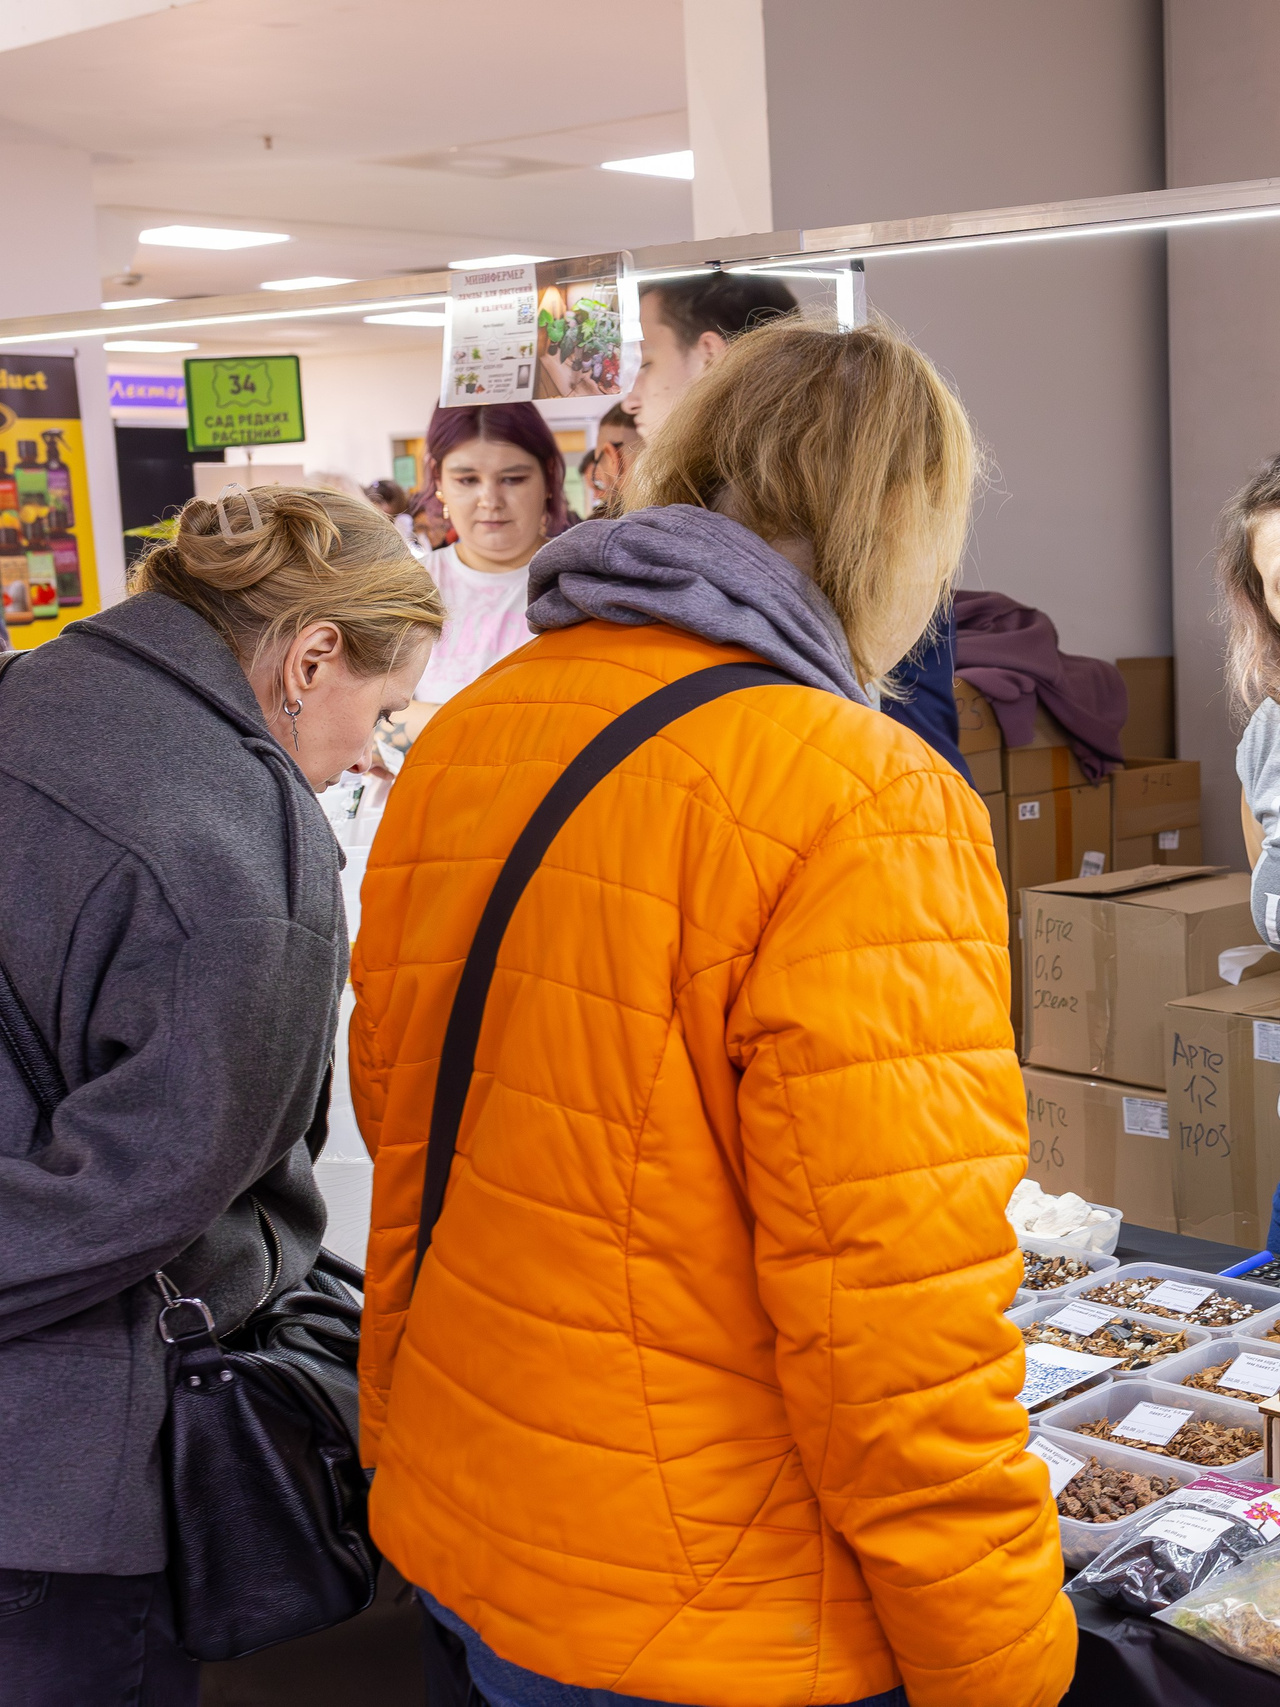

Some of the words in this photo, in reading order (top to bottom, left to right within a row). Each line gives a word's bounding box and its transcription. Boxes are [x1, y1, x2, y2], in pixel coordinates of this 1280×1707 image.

[465, 269, 525, 285] МИНИФЕРМЕР
[228, 375, 256, 395] 34
[205, 416, 234, 427] САД
[239, 412, 289, 426] РЕДКИХ
[212, 428, 281, 442] РАСТЕНИЙ
